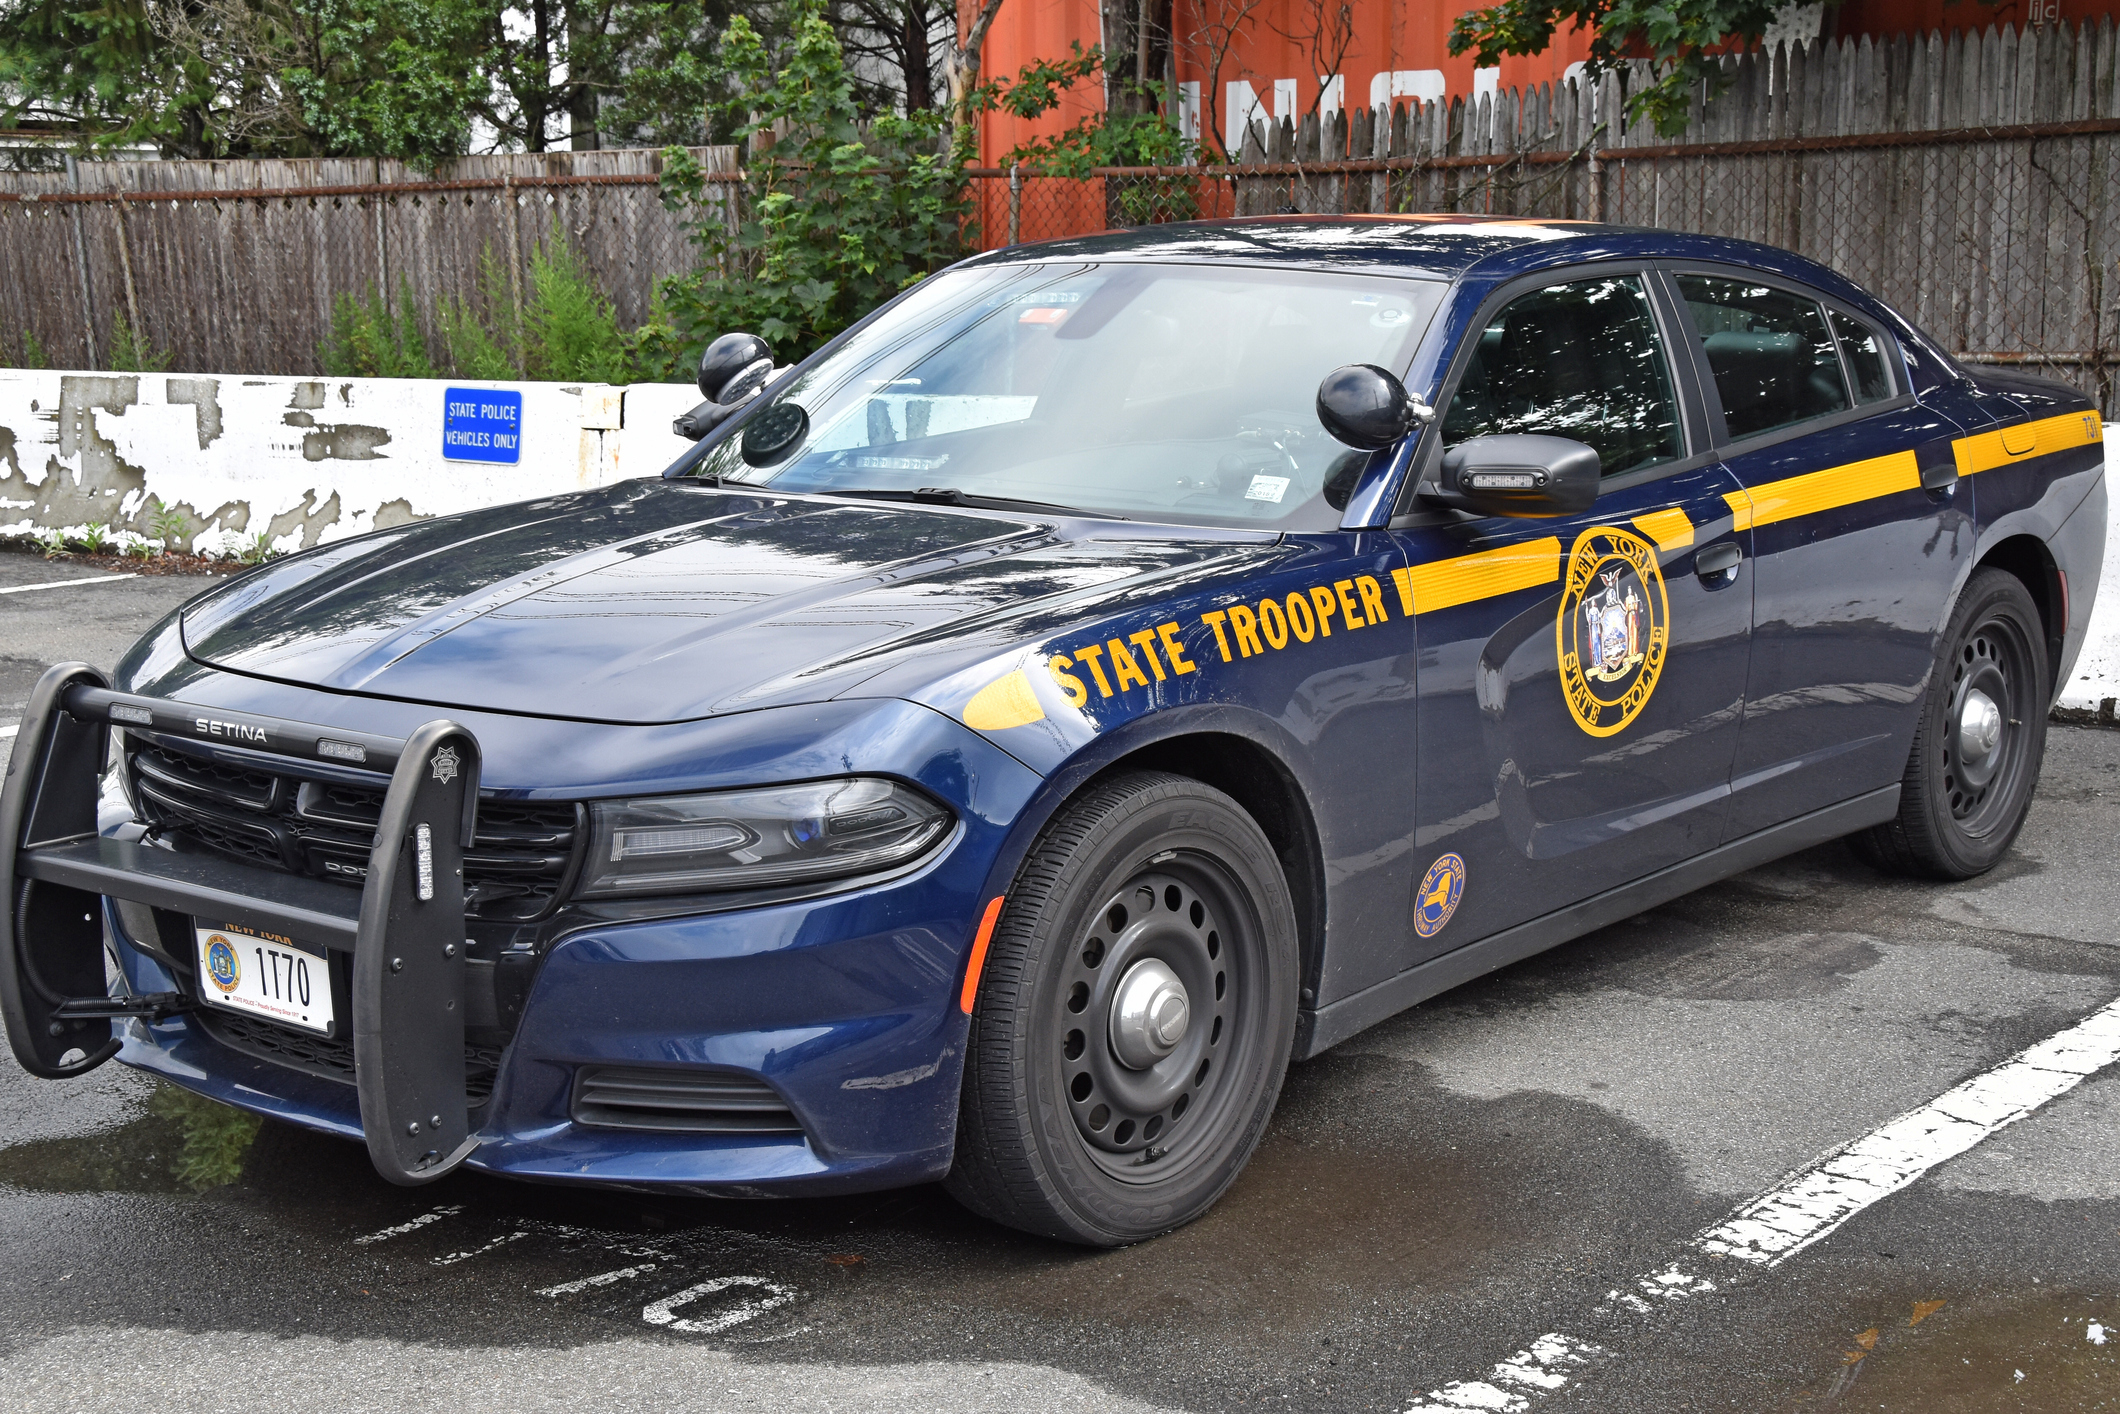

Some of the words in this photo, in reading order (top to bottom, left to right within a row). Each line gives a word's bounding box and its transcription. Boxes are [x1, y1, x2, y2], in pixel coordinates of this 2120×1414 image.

[449, 402, 476, 418] STATE
[481, 404, 517, 421] POLICE
[446, 430, 490, 447] VEHICLES
[493, 433, 518, 449] ONLY
[1570, 541, 1600, 600] NEW
[1605, 535, 1655, 585] YORK
[1049, 621, 1197, 709] STATE
[1201, 575, 1389, 663] TROOPER
[1563, 651, 1602, 726] STATE
[1621, 626, 1664, 720] POLICE
[195, 718, 268, 743] SETINA
[1421, 873, 1433, 895] NEW
[1434, 858, 1450, 873] YORK
[255, 947, 310, 1007] 1T70
